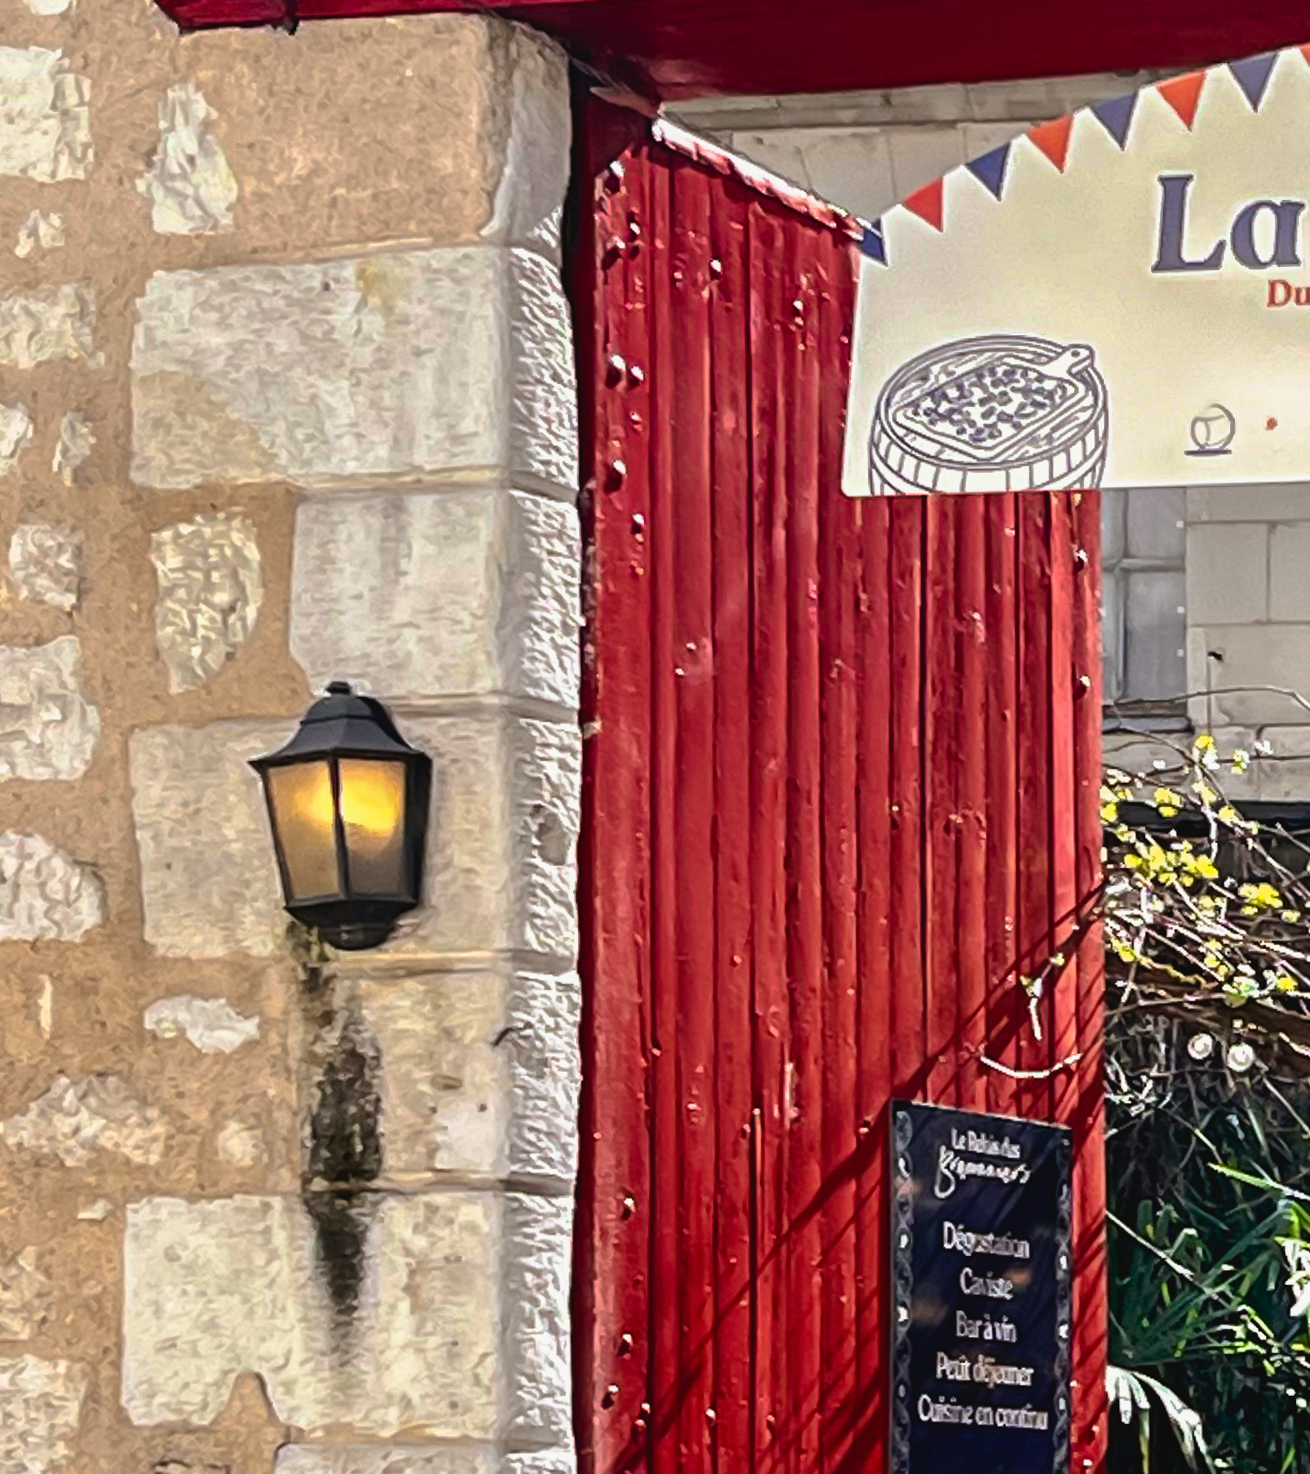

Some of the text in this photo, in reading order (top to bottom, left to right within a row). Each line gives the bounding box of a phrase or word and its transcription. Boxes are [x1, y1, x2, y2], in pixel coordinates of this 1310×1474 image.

[1151, 173, 1307, 273] La
[950, 1127, 967, 1150] Le
[943, 1220, 1030, 1260] Dégustation
[959, 1266, 1014, 1301] Caviste
[956, 1309, 1018, 1343] Bar à vin
[935, 1351, 1035, 1390] Petit déjeuner
[917, 1393, 1049, 1431] Cuisine en continu
